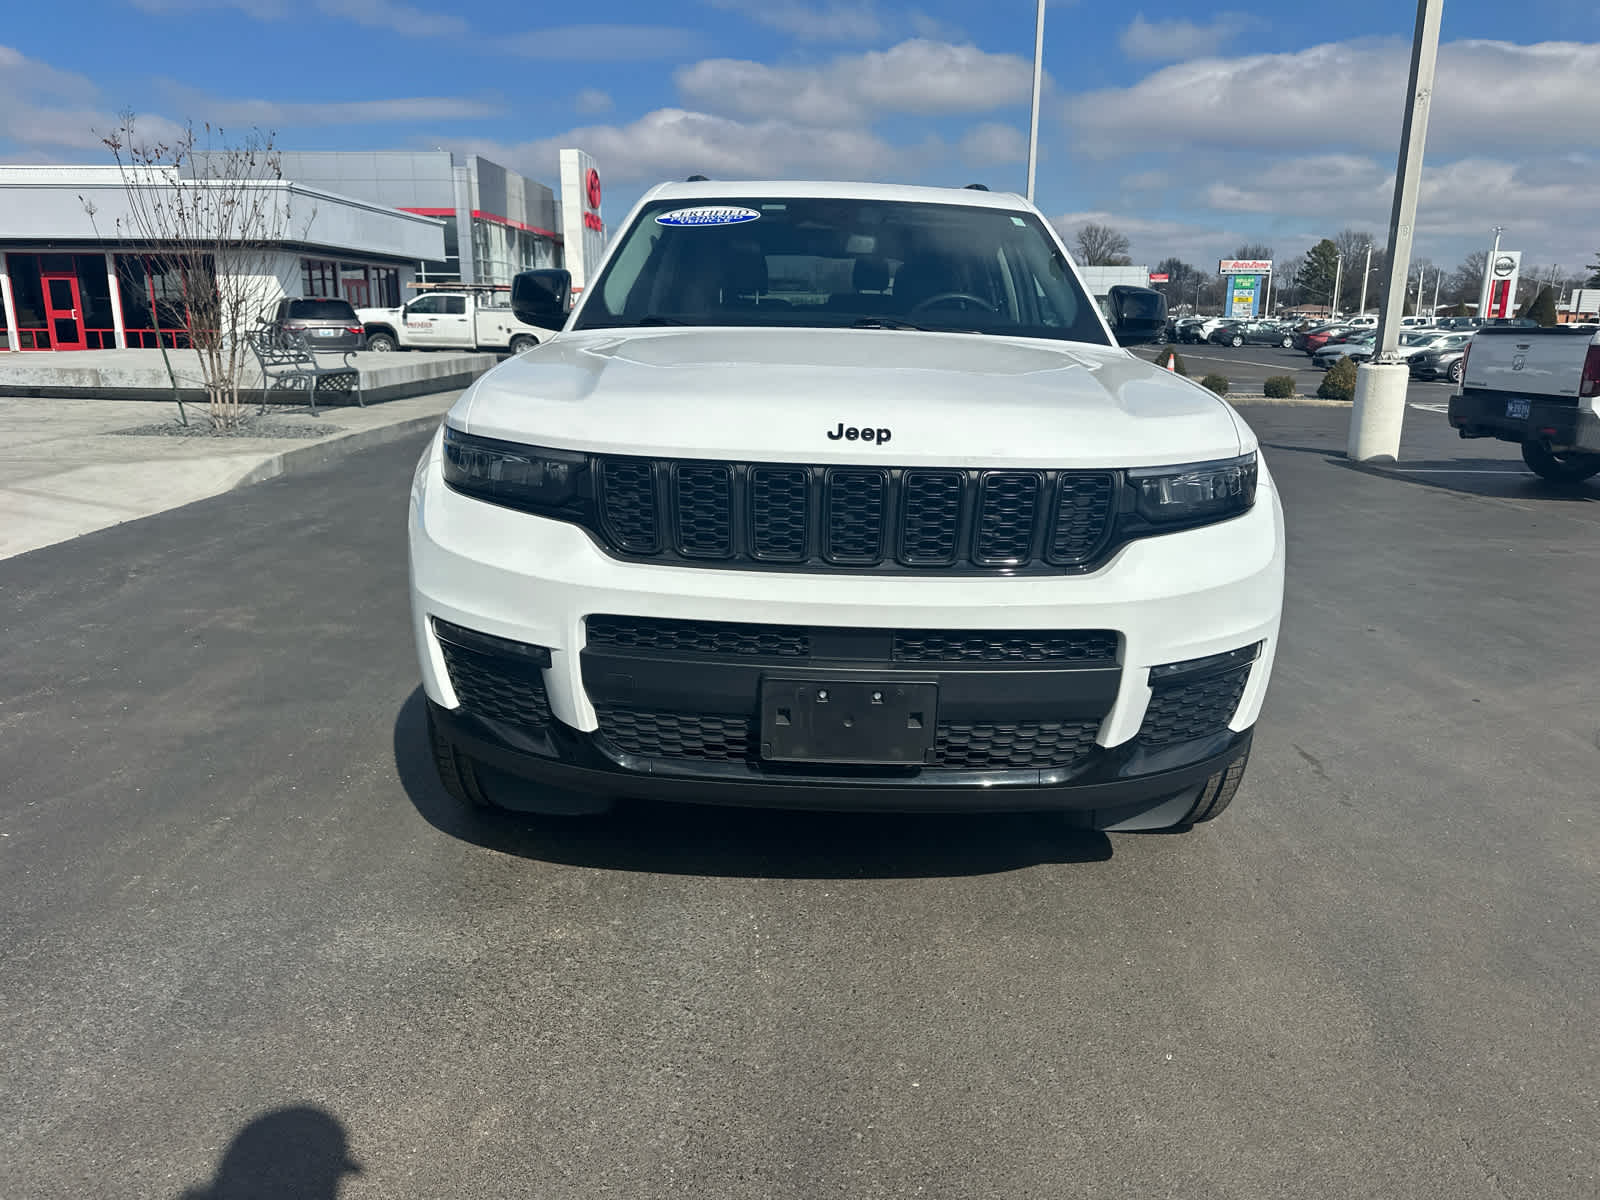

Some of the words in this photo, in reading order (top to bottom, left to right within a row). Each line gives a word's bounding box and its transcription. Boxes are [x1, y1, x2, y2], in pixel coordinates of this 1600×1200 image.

[669, 209, 750, 218] CERTIFIED
[1232, 261, 1269, 269] AutoZone
[827, 423, 892, 445] Jeep
